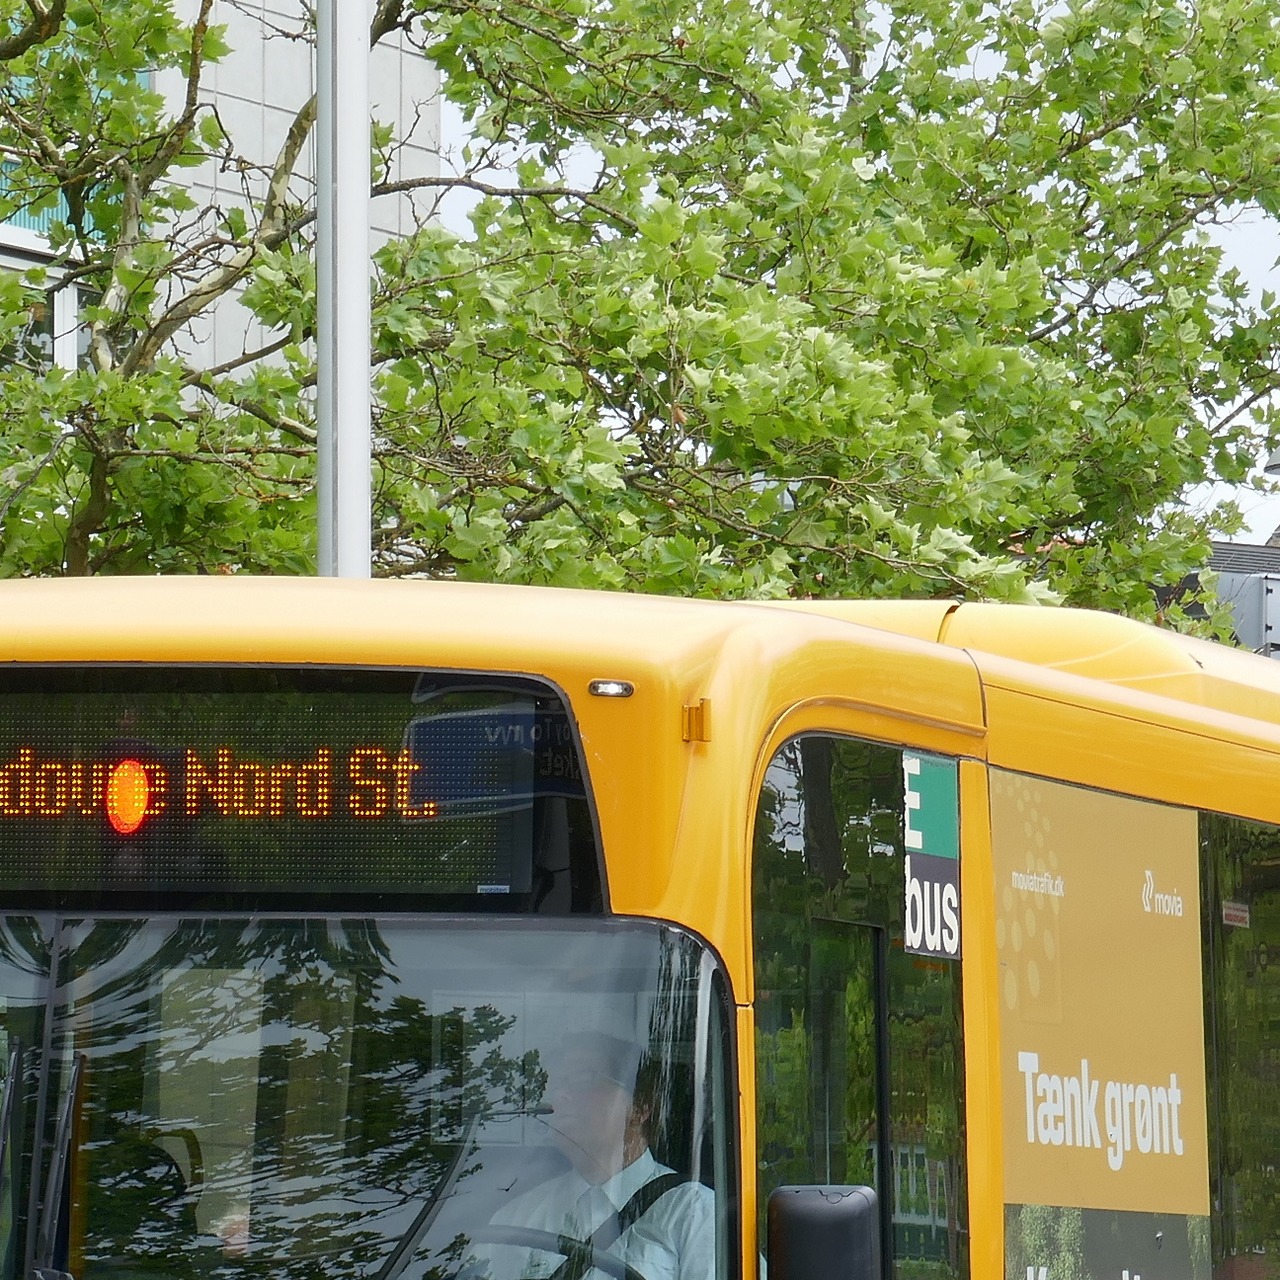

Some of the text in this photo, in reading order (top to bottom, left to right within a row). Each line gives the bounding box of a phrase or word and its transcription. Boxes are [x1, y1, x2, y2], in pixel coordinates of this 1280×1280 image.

[186, 747, 328, 816] Nord
[349, 747, 438, 817] St.
[904, 853, 959, 955] bus
[1154, 888, 1183, 917] movia
[1018, 1051, 1184, 1172] Tænk grønt
